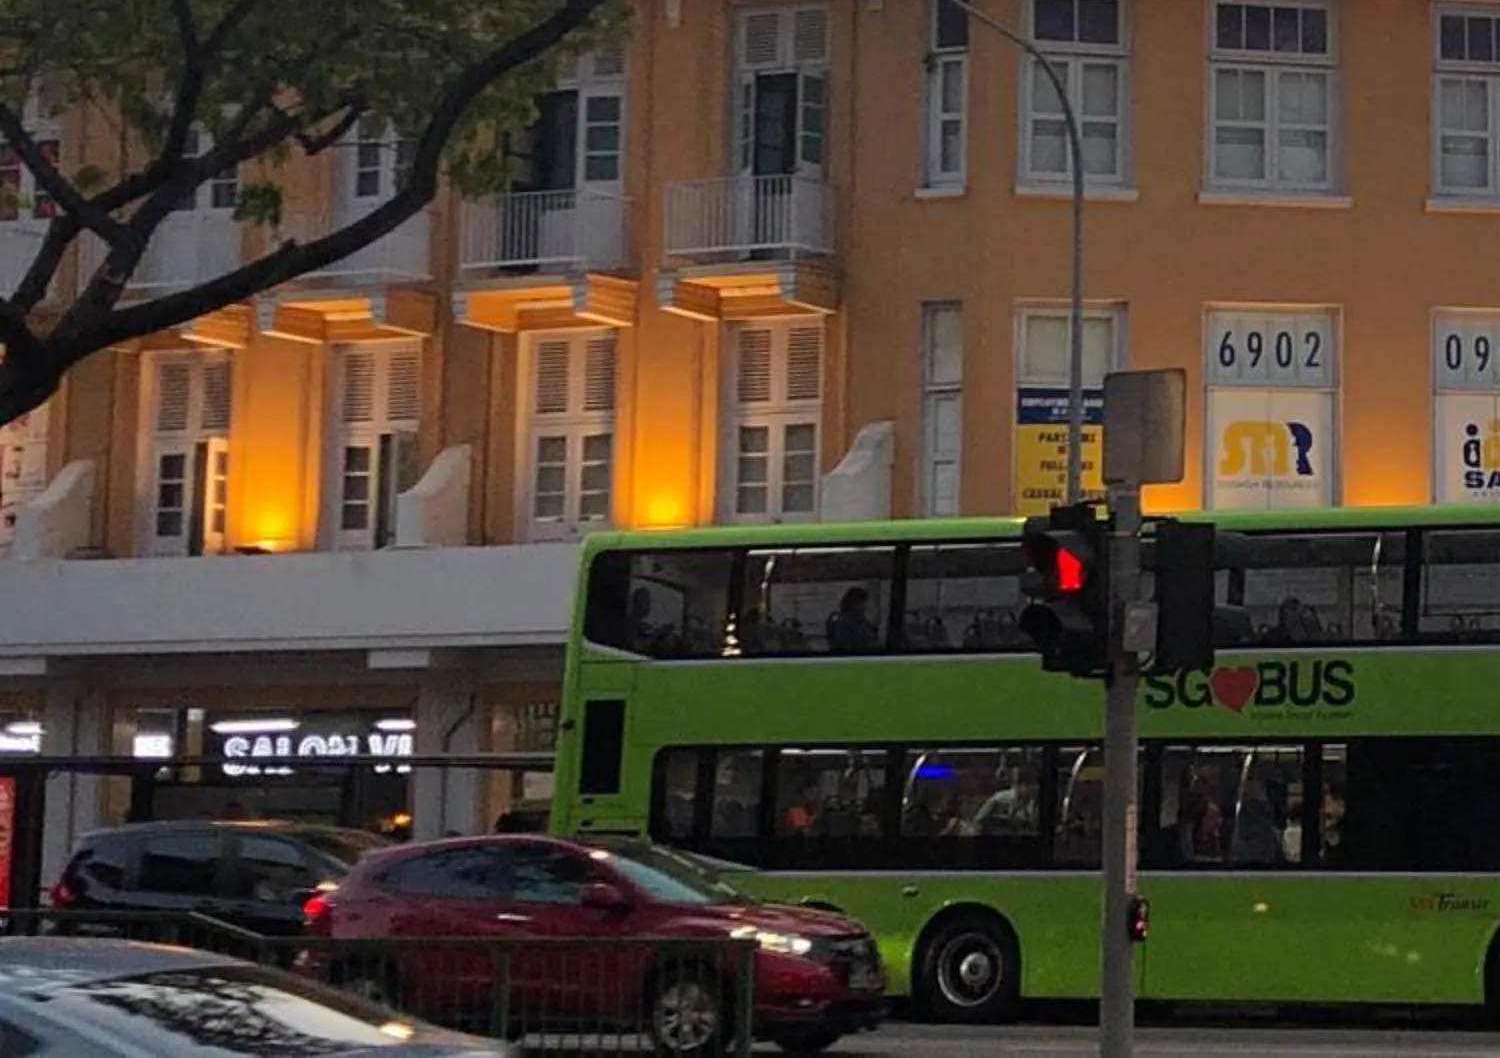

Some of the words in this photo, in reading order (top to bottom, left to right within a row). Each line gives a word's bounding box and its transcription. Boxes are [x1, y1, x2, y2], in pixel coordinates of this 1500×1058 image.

[1218, 330, 1322, 369] 6902
[1144, 670, 1213, 709] SG
[1254, 660, 1355, 707] BUS
